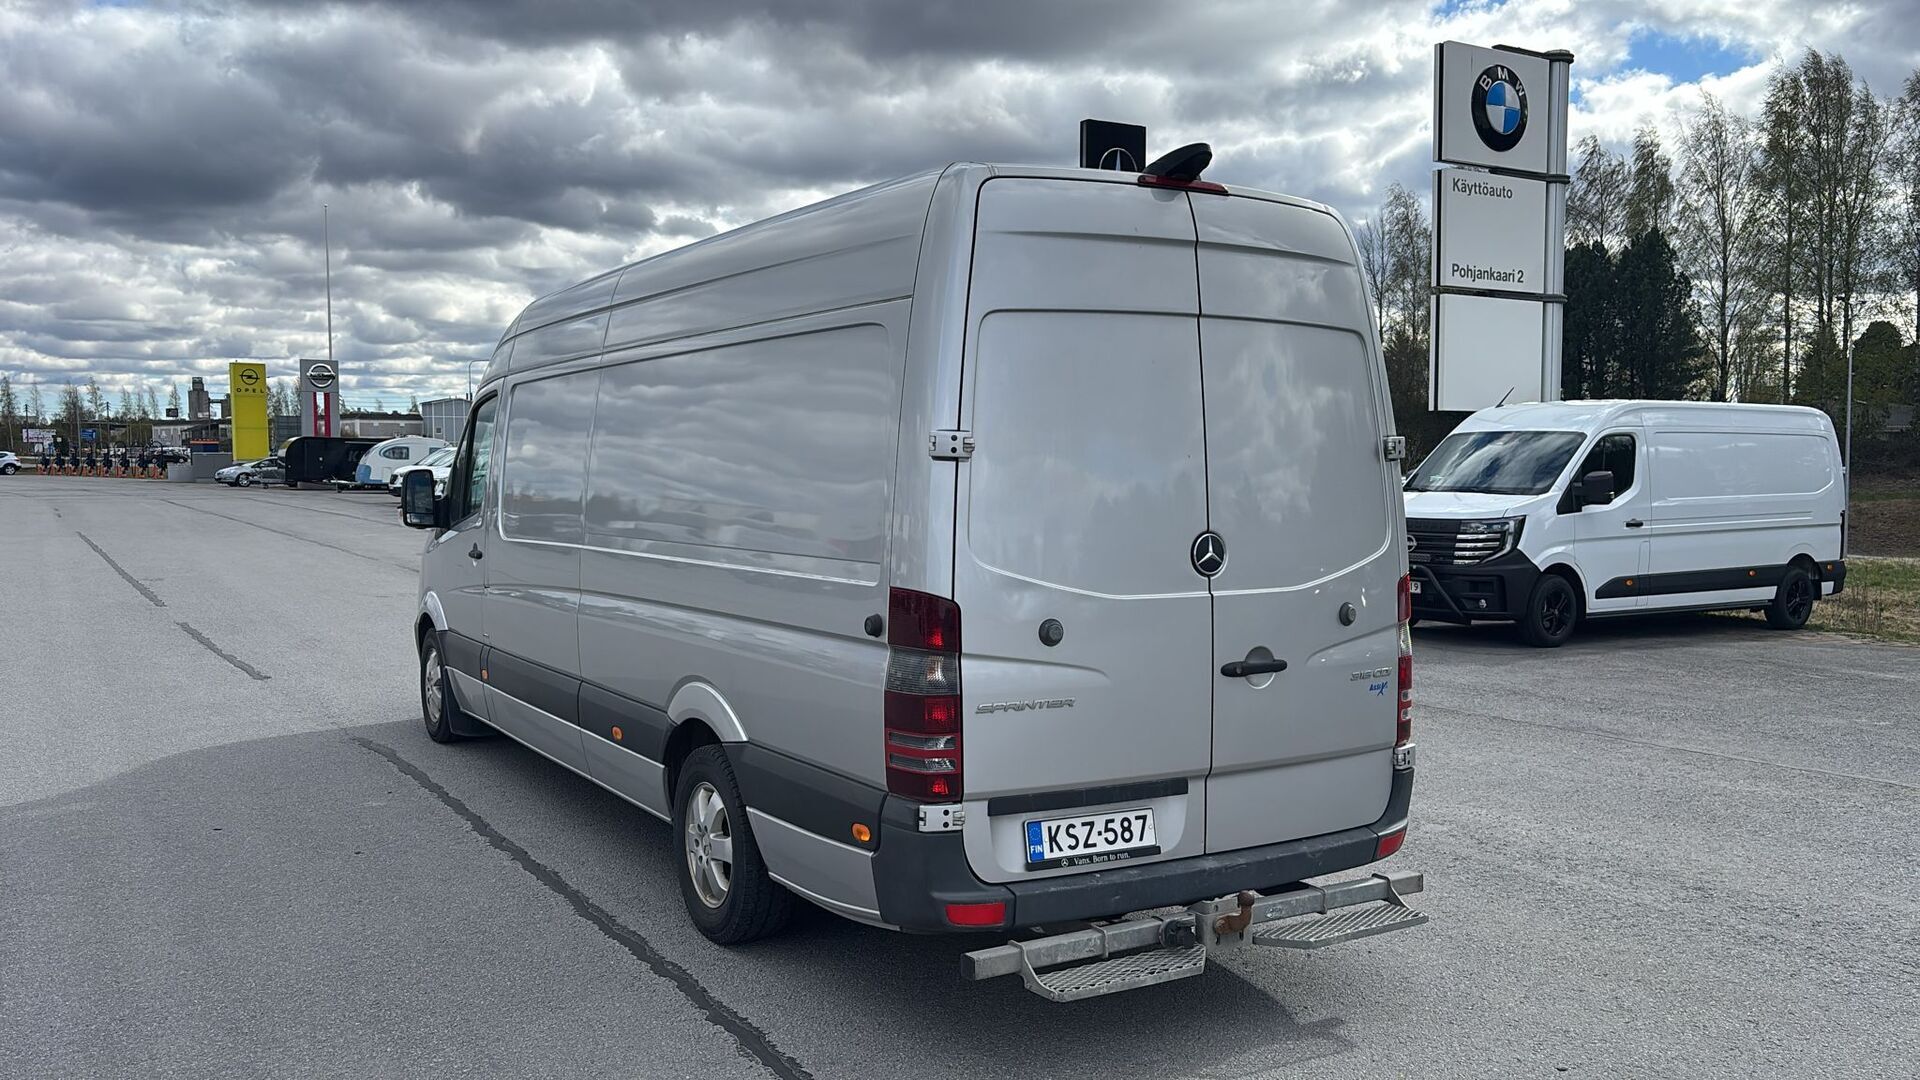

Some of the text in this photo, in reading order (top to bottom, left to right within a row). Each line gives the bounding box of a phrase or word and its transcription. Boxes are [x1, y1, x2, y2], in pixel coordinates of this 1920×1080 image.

[1479, 66, 1526, 97] BMW
[1452, 178, 1513, 199] Käyttöauto
[1452, 263, 1524, 284] Pohjankaari 2
[975, 697, 1076, 714] SPRINTER
[1030, 814, 1148, 854] FIN KSZ-587
[1074, 857, 1091, 866] Vans.
[1093, 855, 1108, 864] Born
[1117, 852, 1131, 860] run.
